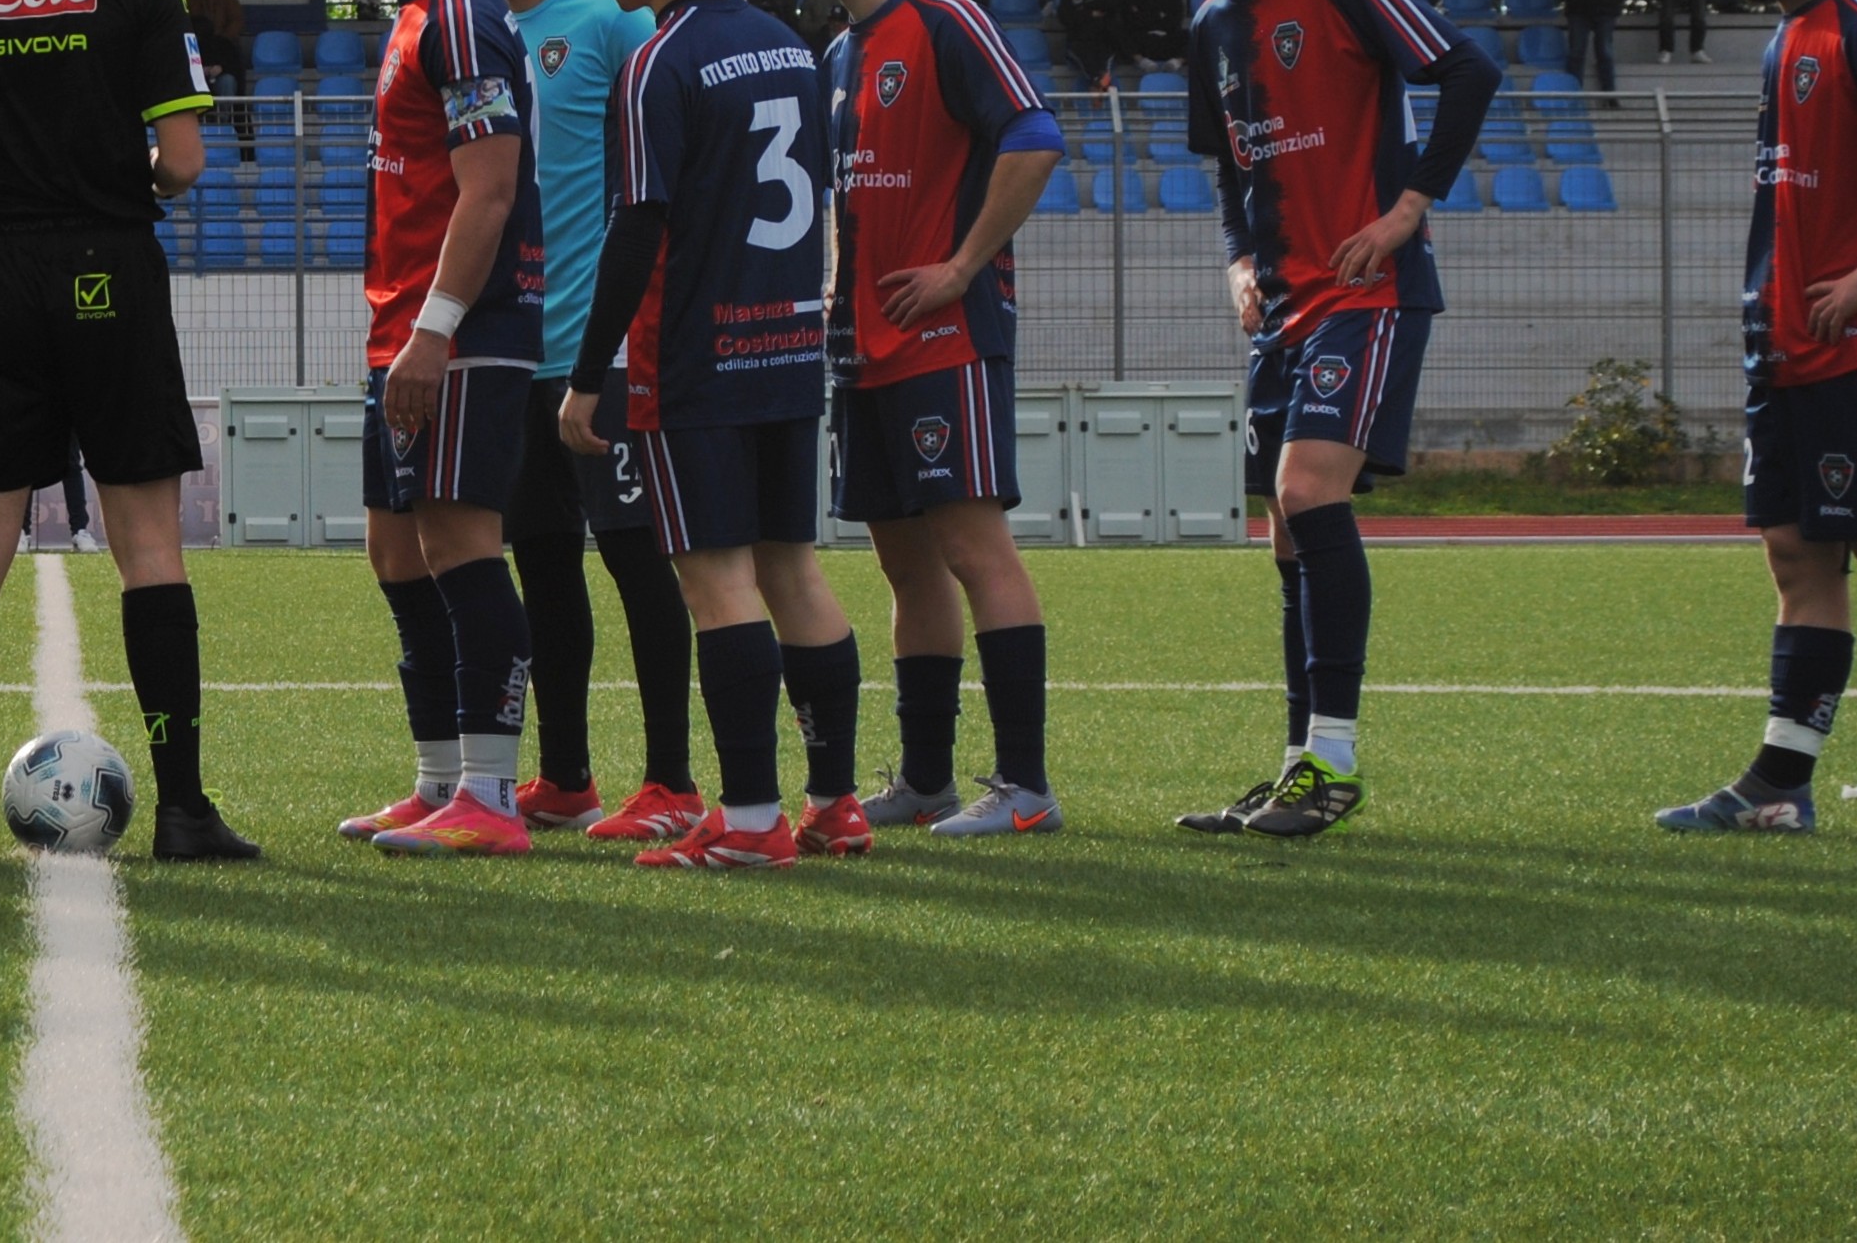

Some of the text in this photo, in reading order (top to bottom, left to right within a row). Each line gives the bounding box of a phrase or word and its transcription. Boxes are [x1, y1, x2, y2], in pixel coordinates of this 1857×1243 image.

[700, 47, 817, 89] ATLETICO BISCEGLIE
[1248, 126, 1326, 162] ostruzioni
[746, 96, 815, 250] 3
[75, 310, 116, 320] GIVOVA
[713, 300, 795, 325] Maenza
[716, 359, 760, 372] edilizia
[761, 358, 768, 367] e
[769, 348, 821, 366] costruzioni
[1245, 407, 1260, 455] 6
